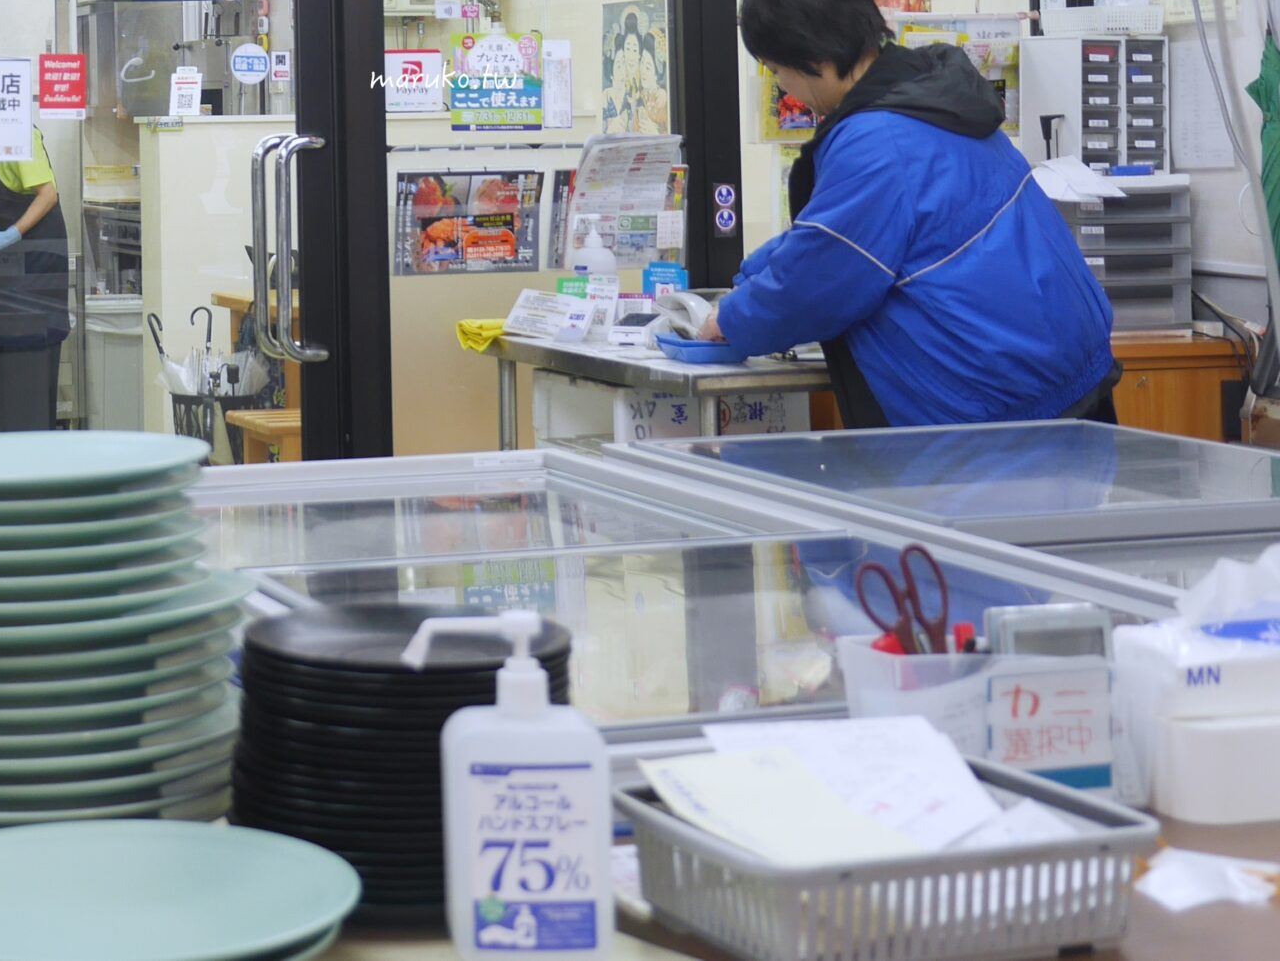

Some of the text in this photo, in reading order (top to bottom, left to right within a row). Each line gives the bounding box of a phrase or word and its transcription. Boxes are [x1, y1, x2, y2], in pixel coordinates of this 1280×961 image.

[476, 53, 517, 63] プレミアム
[454, 91, 539, 107] ここで使えます
[1000, 684, 1094, 719] カニ
[493, 794, 572, 811] アルコール
[477, 815, 588, 832] ハンドスプレー
[478, 839, 591, 892] 75%
